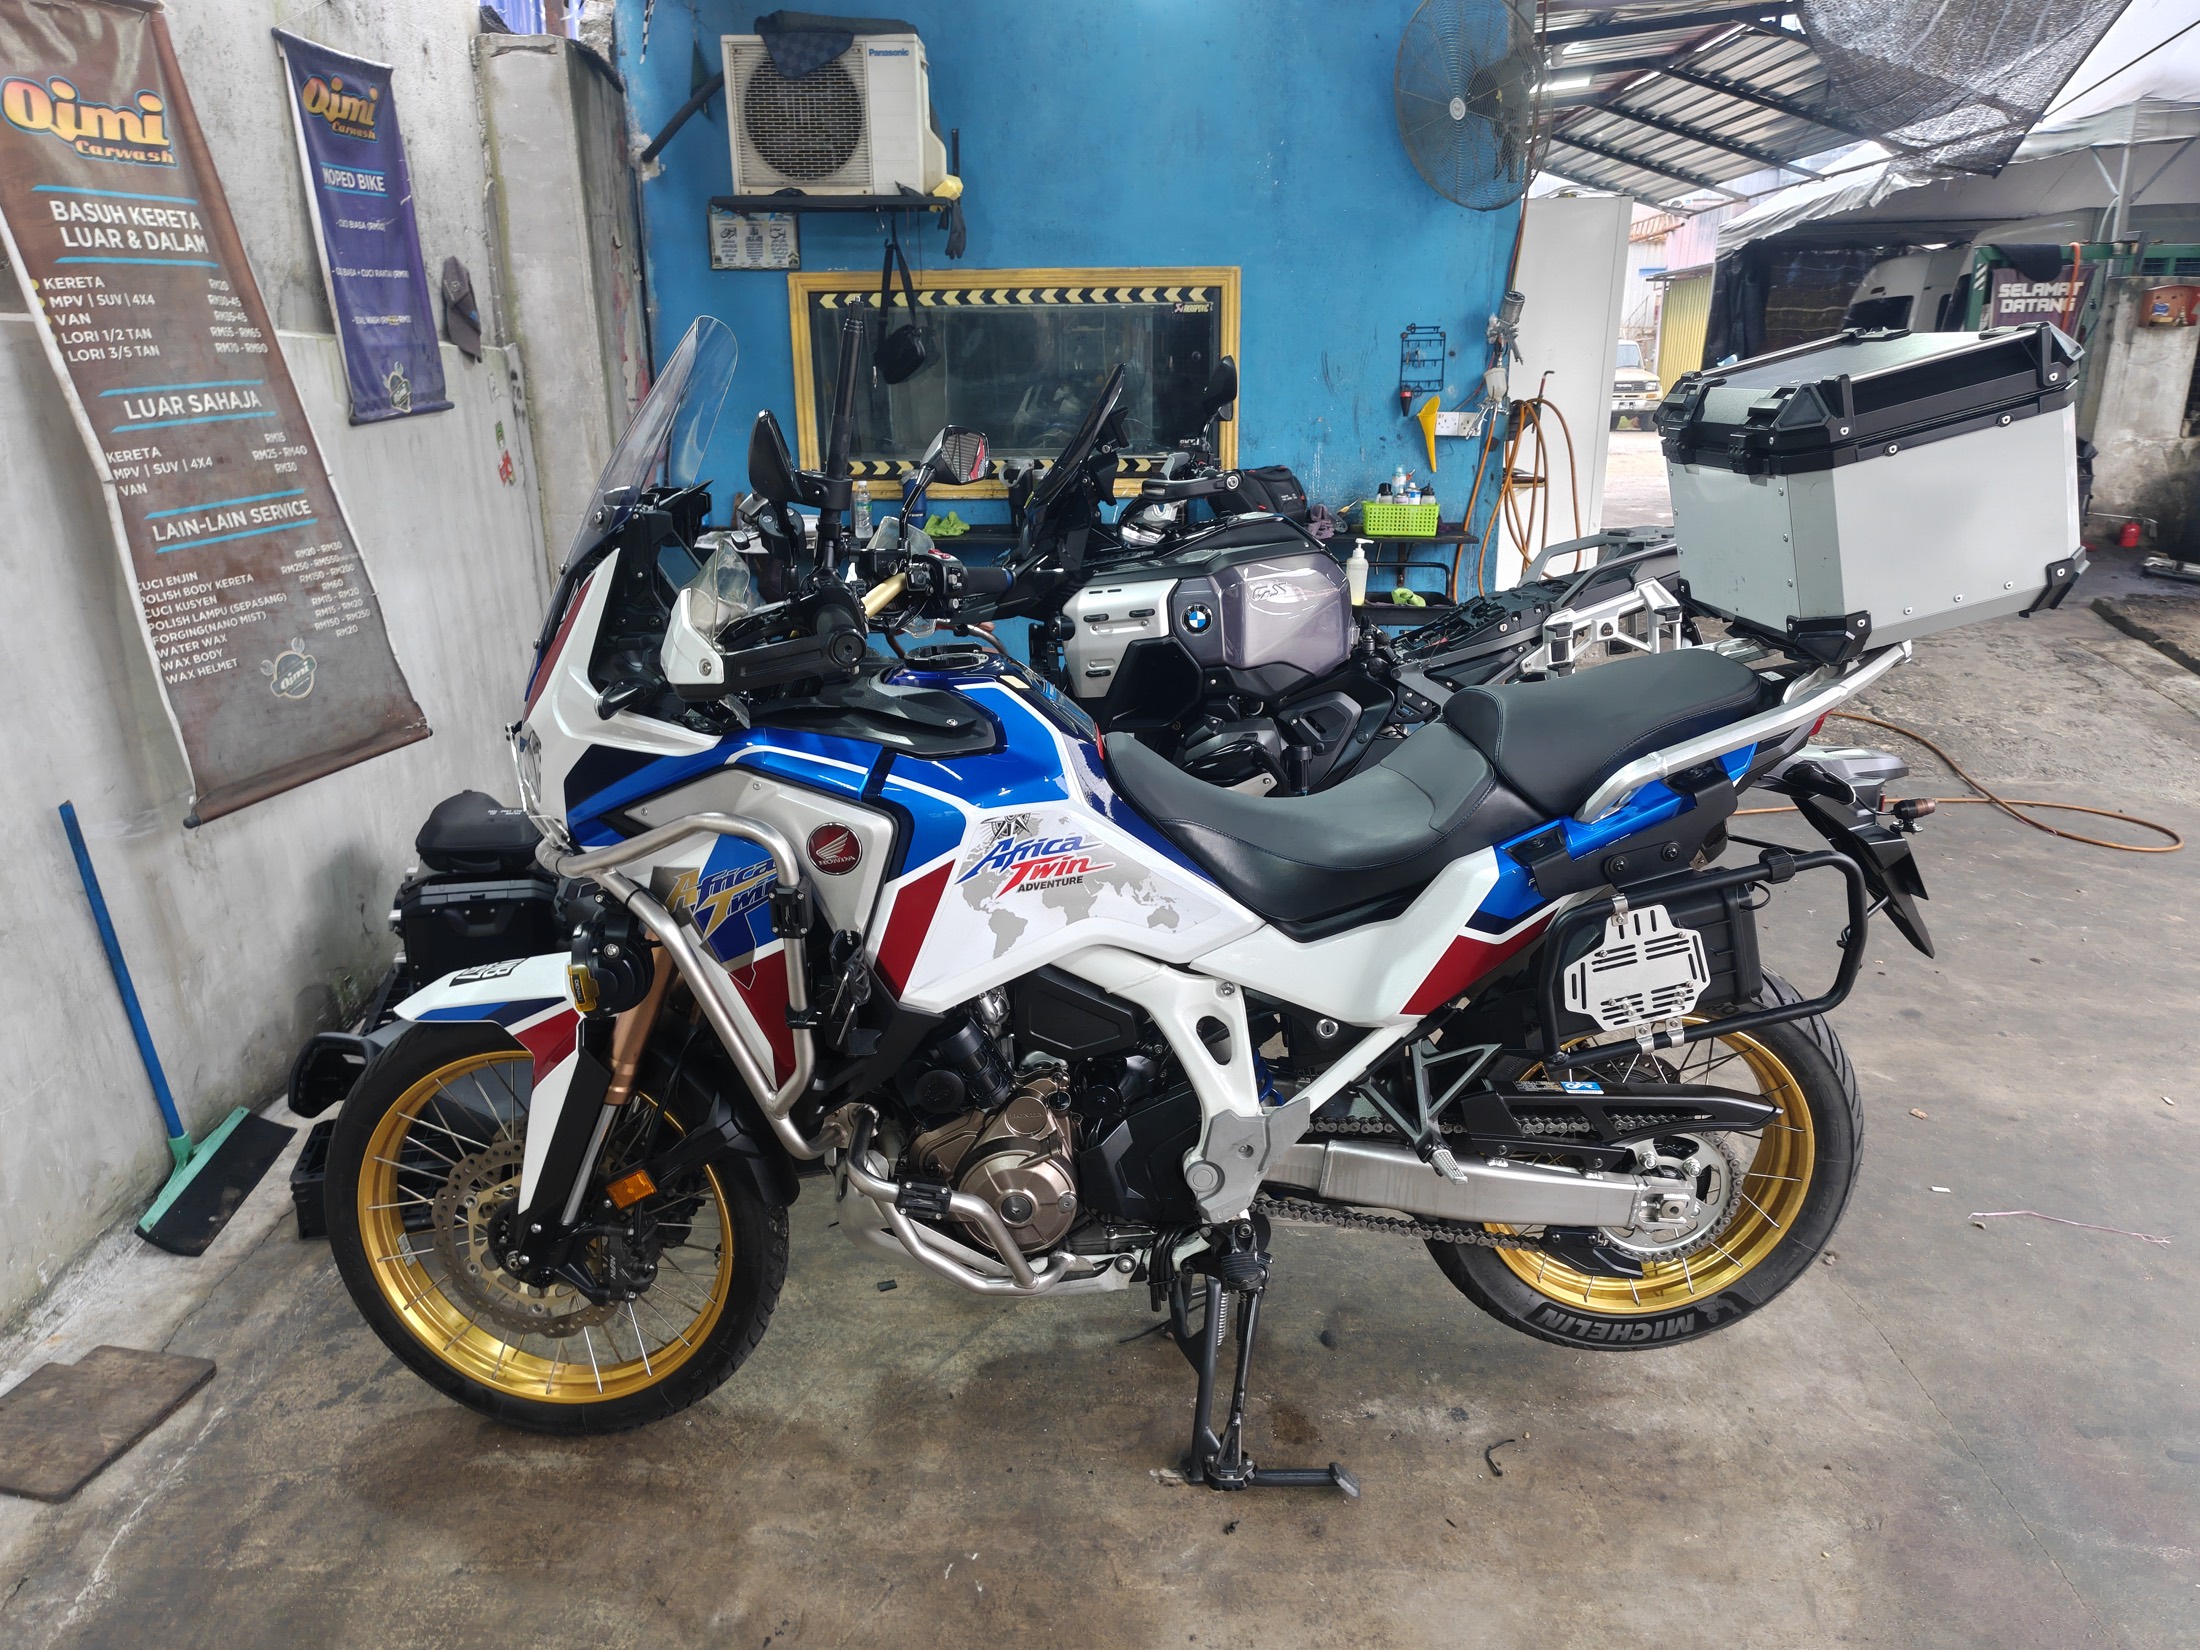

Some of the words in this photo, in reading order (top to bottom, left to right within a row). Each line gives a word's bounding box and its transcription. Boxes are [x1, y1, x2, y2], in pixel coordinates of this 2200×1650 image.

[868, 48, 910, 56] Panasonic
[303, 77, 378, 126] Qimi
[3, 80, 170, 146] Qimi
[332, 121, 377, 139] Carwash
[75, 140, 175, 164] Carwash
[322, 167, 356, 188] MOPED
[356, 173, 386, 192] BIKE
[49, 200, 128, 225] BASUH
[128, 206, 203, 231] KERETA
[60, 227, 123, 249] LUAR
[127, 231, 142, 249] &
[143, 230, 209, 253] DALAM
[43, 276, 105, 290] KERETA
[1998, 281, 2084, 298] SELAMAT
[49, 295, 83, 308] MPV
[96, 294, 122, 306] SUV
[132, 294, 155, 306] 4X4
[55, 312, 92, 326] VAN
[61, 330, 100, 345] LORI
[102, 328, 124, 343] 1/2
[126, 328, 152, 340] TAN
[67, 349, 105, 362] LORI
[110, 346, 132, 360] 3/5
[134, 345, 160, 358] TAN
[123, 395, 186, 420] LUAR
[187, 390, 262, 414] SAHAJA
[105, 446, 162, 464] KERETA
[252, 448, 277, 462] RM25
[282, 445, 308, 458] RM40
[112, 464, 140, 481] MPV
[153, 461, 179, 476] SUV
[190, 456, 214, 469] 4X4
[274, 461, 298, 474] RM30
[119, 482, 148, 497] VAN
[152, 510, 247, 543] LAIN-LAIN
[250, 499, 312, 524] SERVICE
[295, 546, 316, 559] RM20
[320, 540, 343, 553] RM30
[280, 561, 310, 575] RM250
[313, 554, 340, 567] RM550
[299, 570, 325, 583] RM150
[330, 563, 355, 576] RM200
[166, 571, 199, 587] ENJIN
[183, 581, 212, 597] BODY
[215, 573, 254, 590] KERETA
[311, 593, 332, 606] RM15
[338, 587, 360, 599] RM20
[145, 604, 173, 619] CUCI
[175, 595, 218, 613] KUSYEN
[192, 605, 228, 623] LAMPU
[229, 592, 288, 615] (SEPASANG)
[315, 605, 336, 618] RM15
[342, 598, 364, 611] RM20
[239, 610, 267, 625] MIST)
[314, 616, 340, 631] RM150
[346, 608, 371, 622] RM250
[335, 624, 359, 637] RM20
[157, 641, 200, 659] WATER
[201, 633, 228, 648] WAX
[161, 656, 191, 672] WAX
[193, 648, 223, 664] BODY
[165, 669, 196, 685] WAX
[197, 658, 238, 677] HELMET
[817, 855, 857, 866] HONDA
[955, 836, 1104, 885] Africa
[995, 855, 1114, 899] Twin
[1016, 875, 1084, 893] ADVENTURE
[1536, 1308, 1696, 1341] MICHELIN
